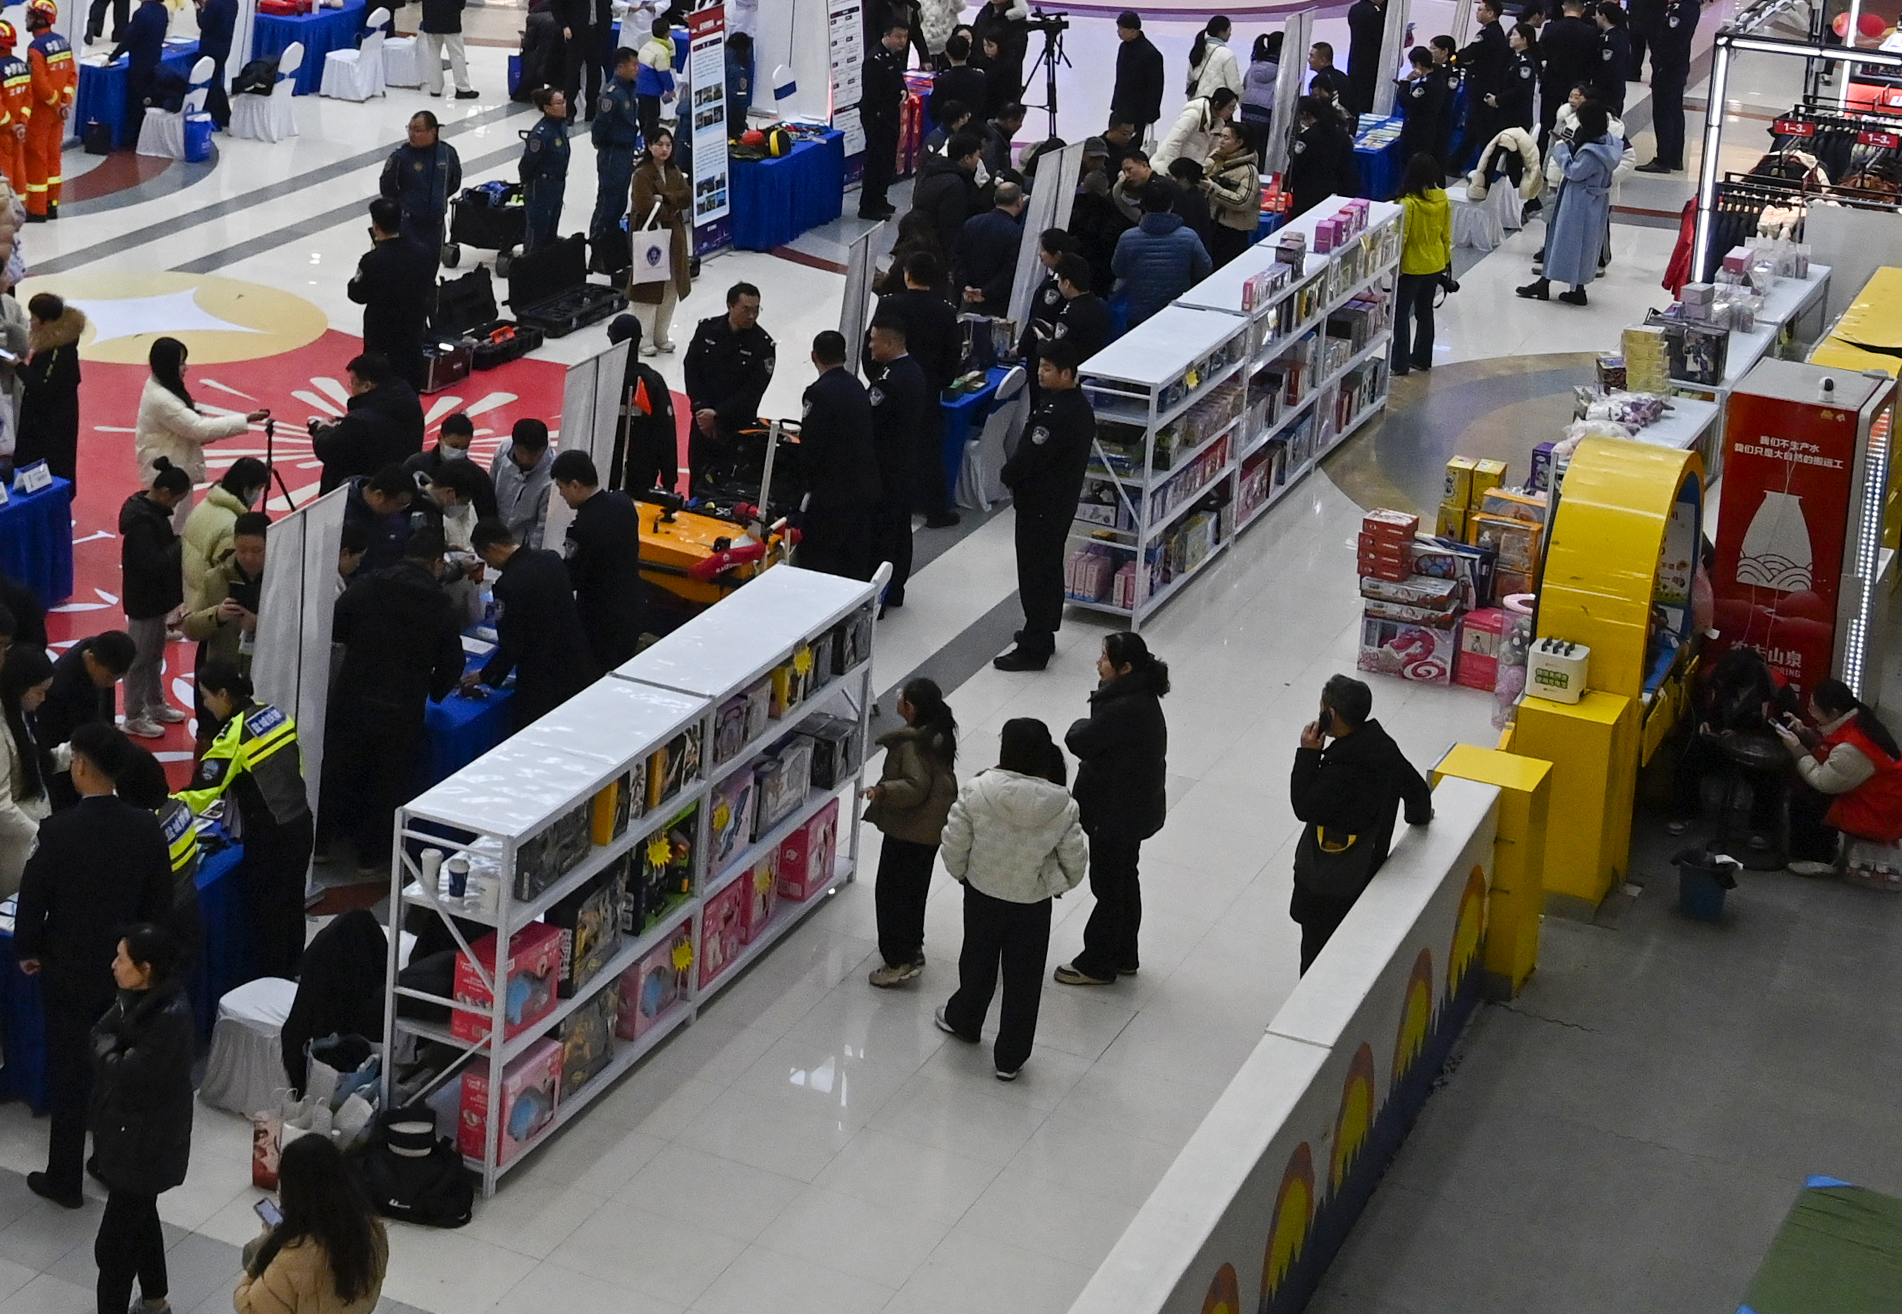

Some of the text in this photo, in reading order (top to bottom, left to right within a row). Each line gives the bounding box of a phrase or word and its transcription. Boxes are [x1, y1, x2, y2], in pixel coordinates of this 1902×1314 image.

[1759, 435, 1821, 453] 我们不生产水
[1734, 442, 1844, 470] 我们只是大自然的搬运工
